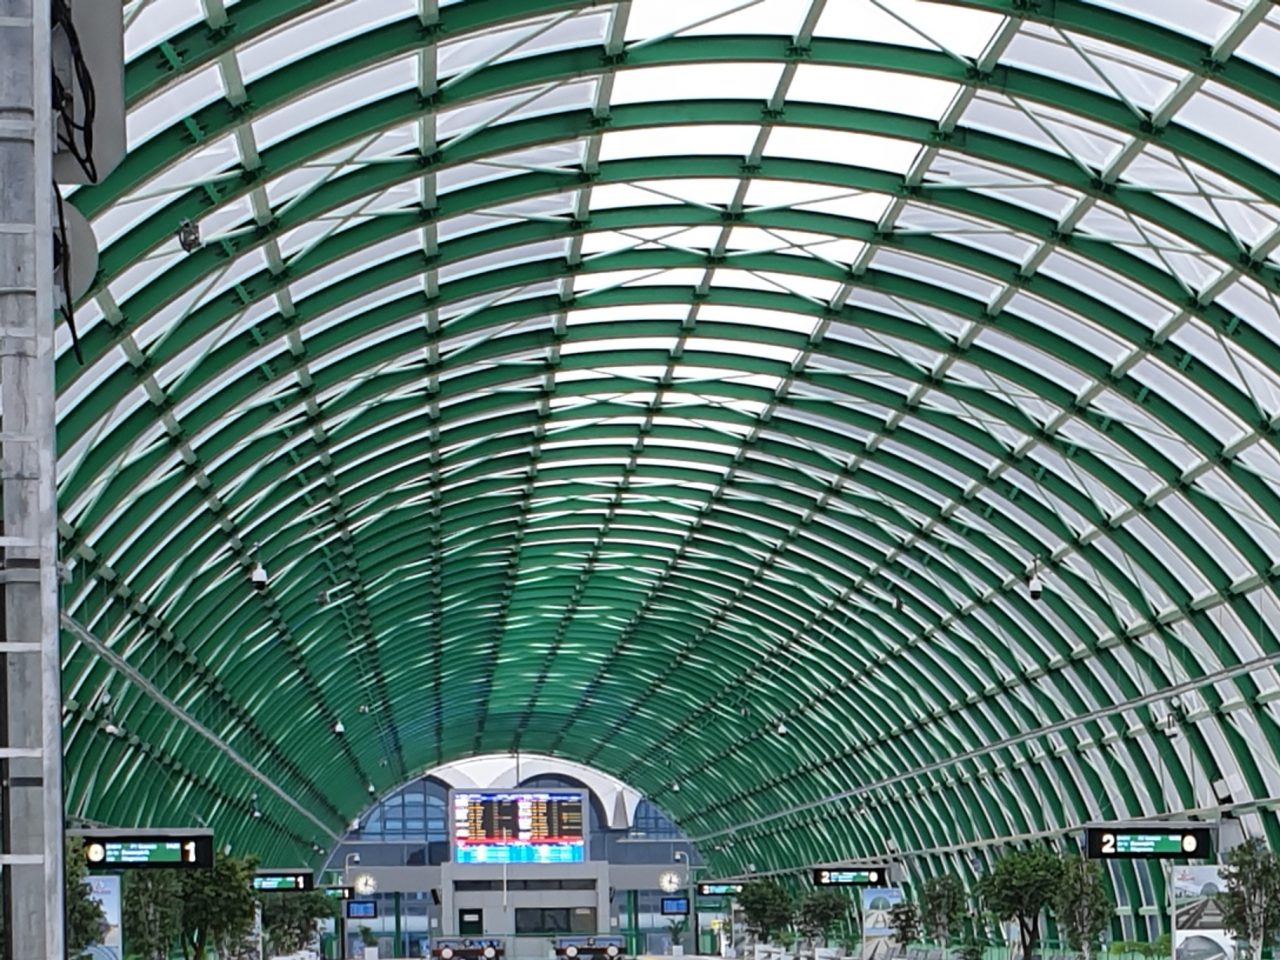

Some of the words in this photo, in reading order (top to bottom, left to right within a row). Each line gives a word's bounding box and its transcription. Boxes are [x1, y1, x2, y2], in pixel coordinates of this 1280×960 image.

[1101, 833, 1115, 853] 2
[184, 841, 196, 863] 1
[297, 876, 304, 889] 1
[820, 871, 830, 884] 2
